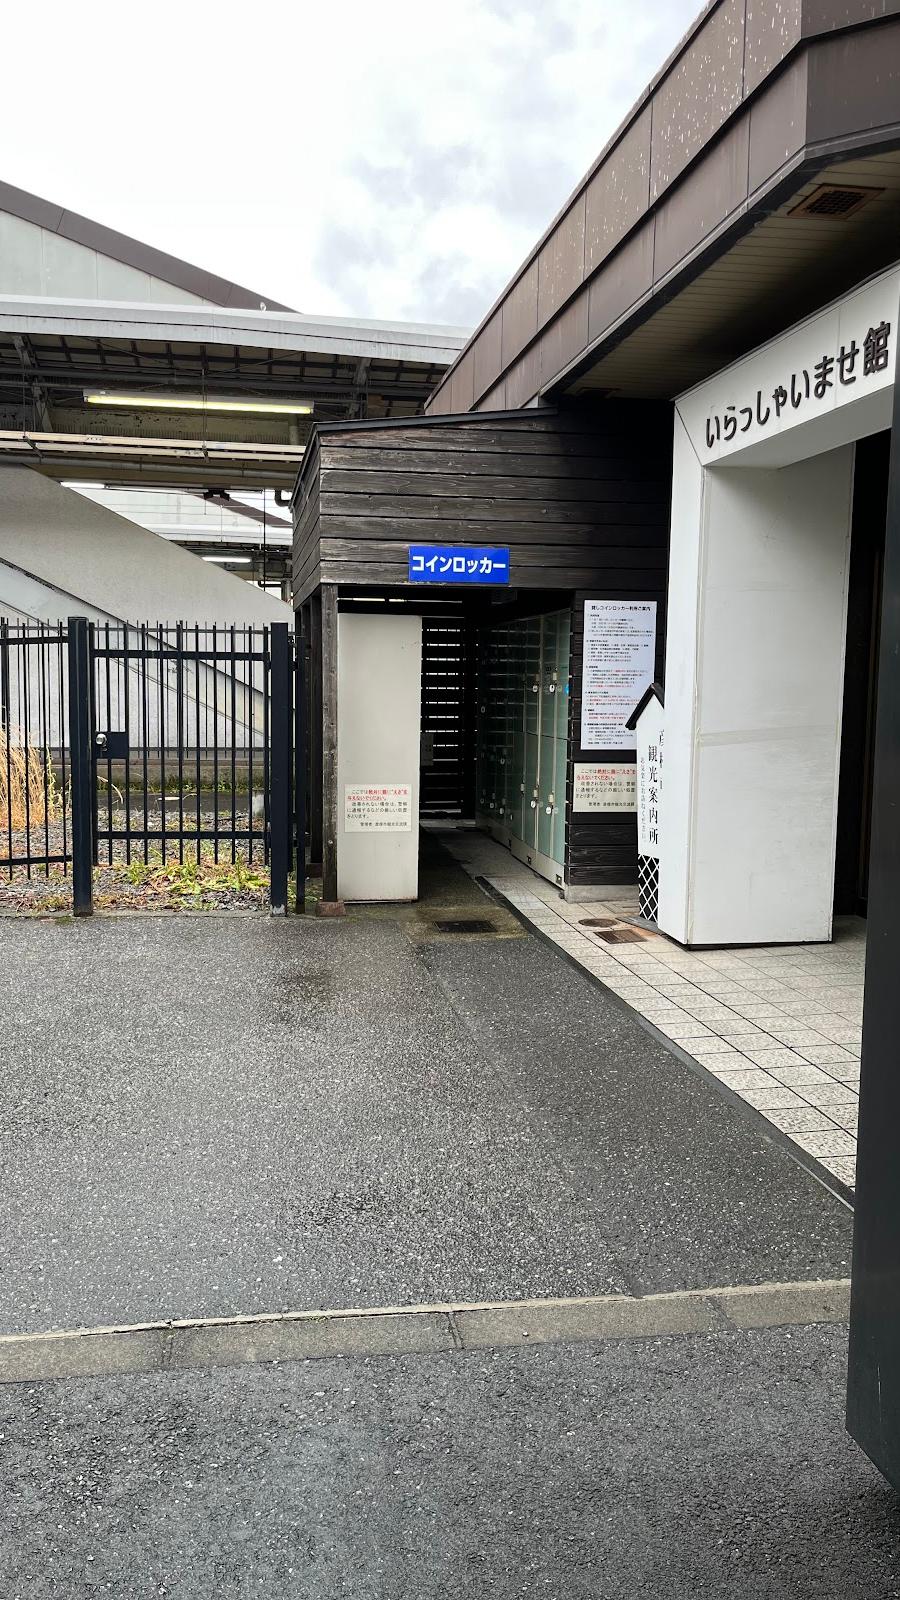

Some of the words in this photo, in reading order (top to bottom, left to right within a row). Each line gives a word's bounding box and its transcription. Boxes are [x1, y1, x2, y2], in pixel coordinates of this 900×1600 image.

[705, 321, 891, 448] いらっしゃいませ館
[412, 555, 506, 574] コインロッカー
[648, 745, 658, 845] 観光案内所
